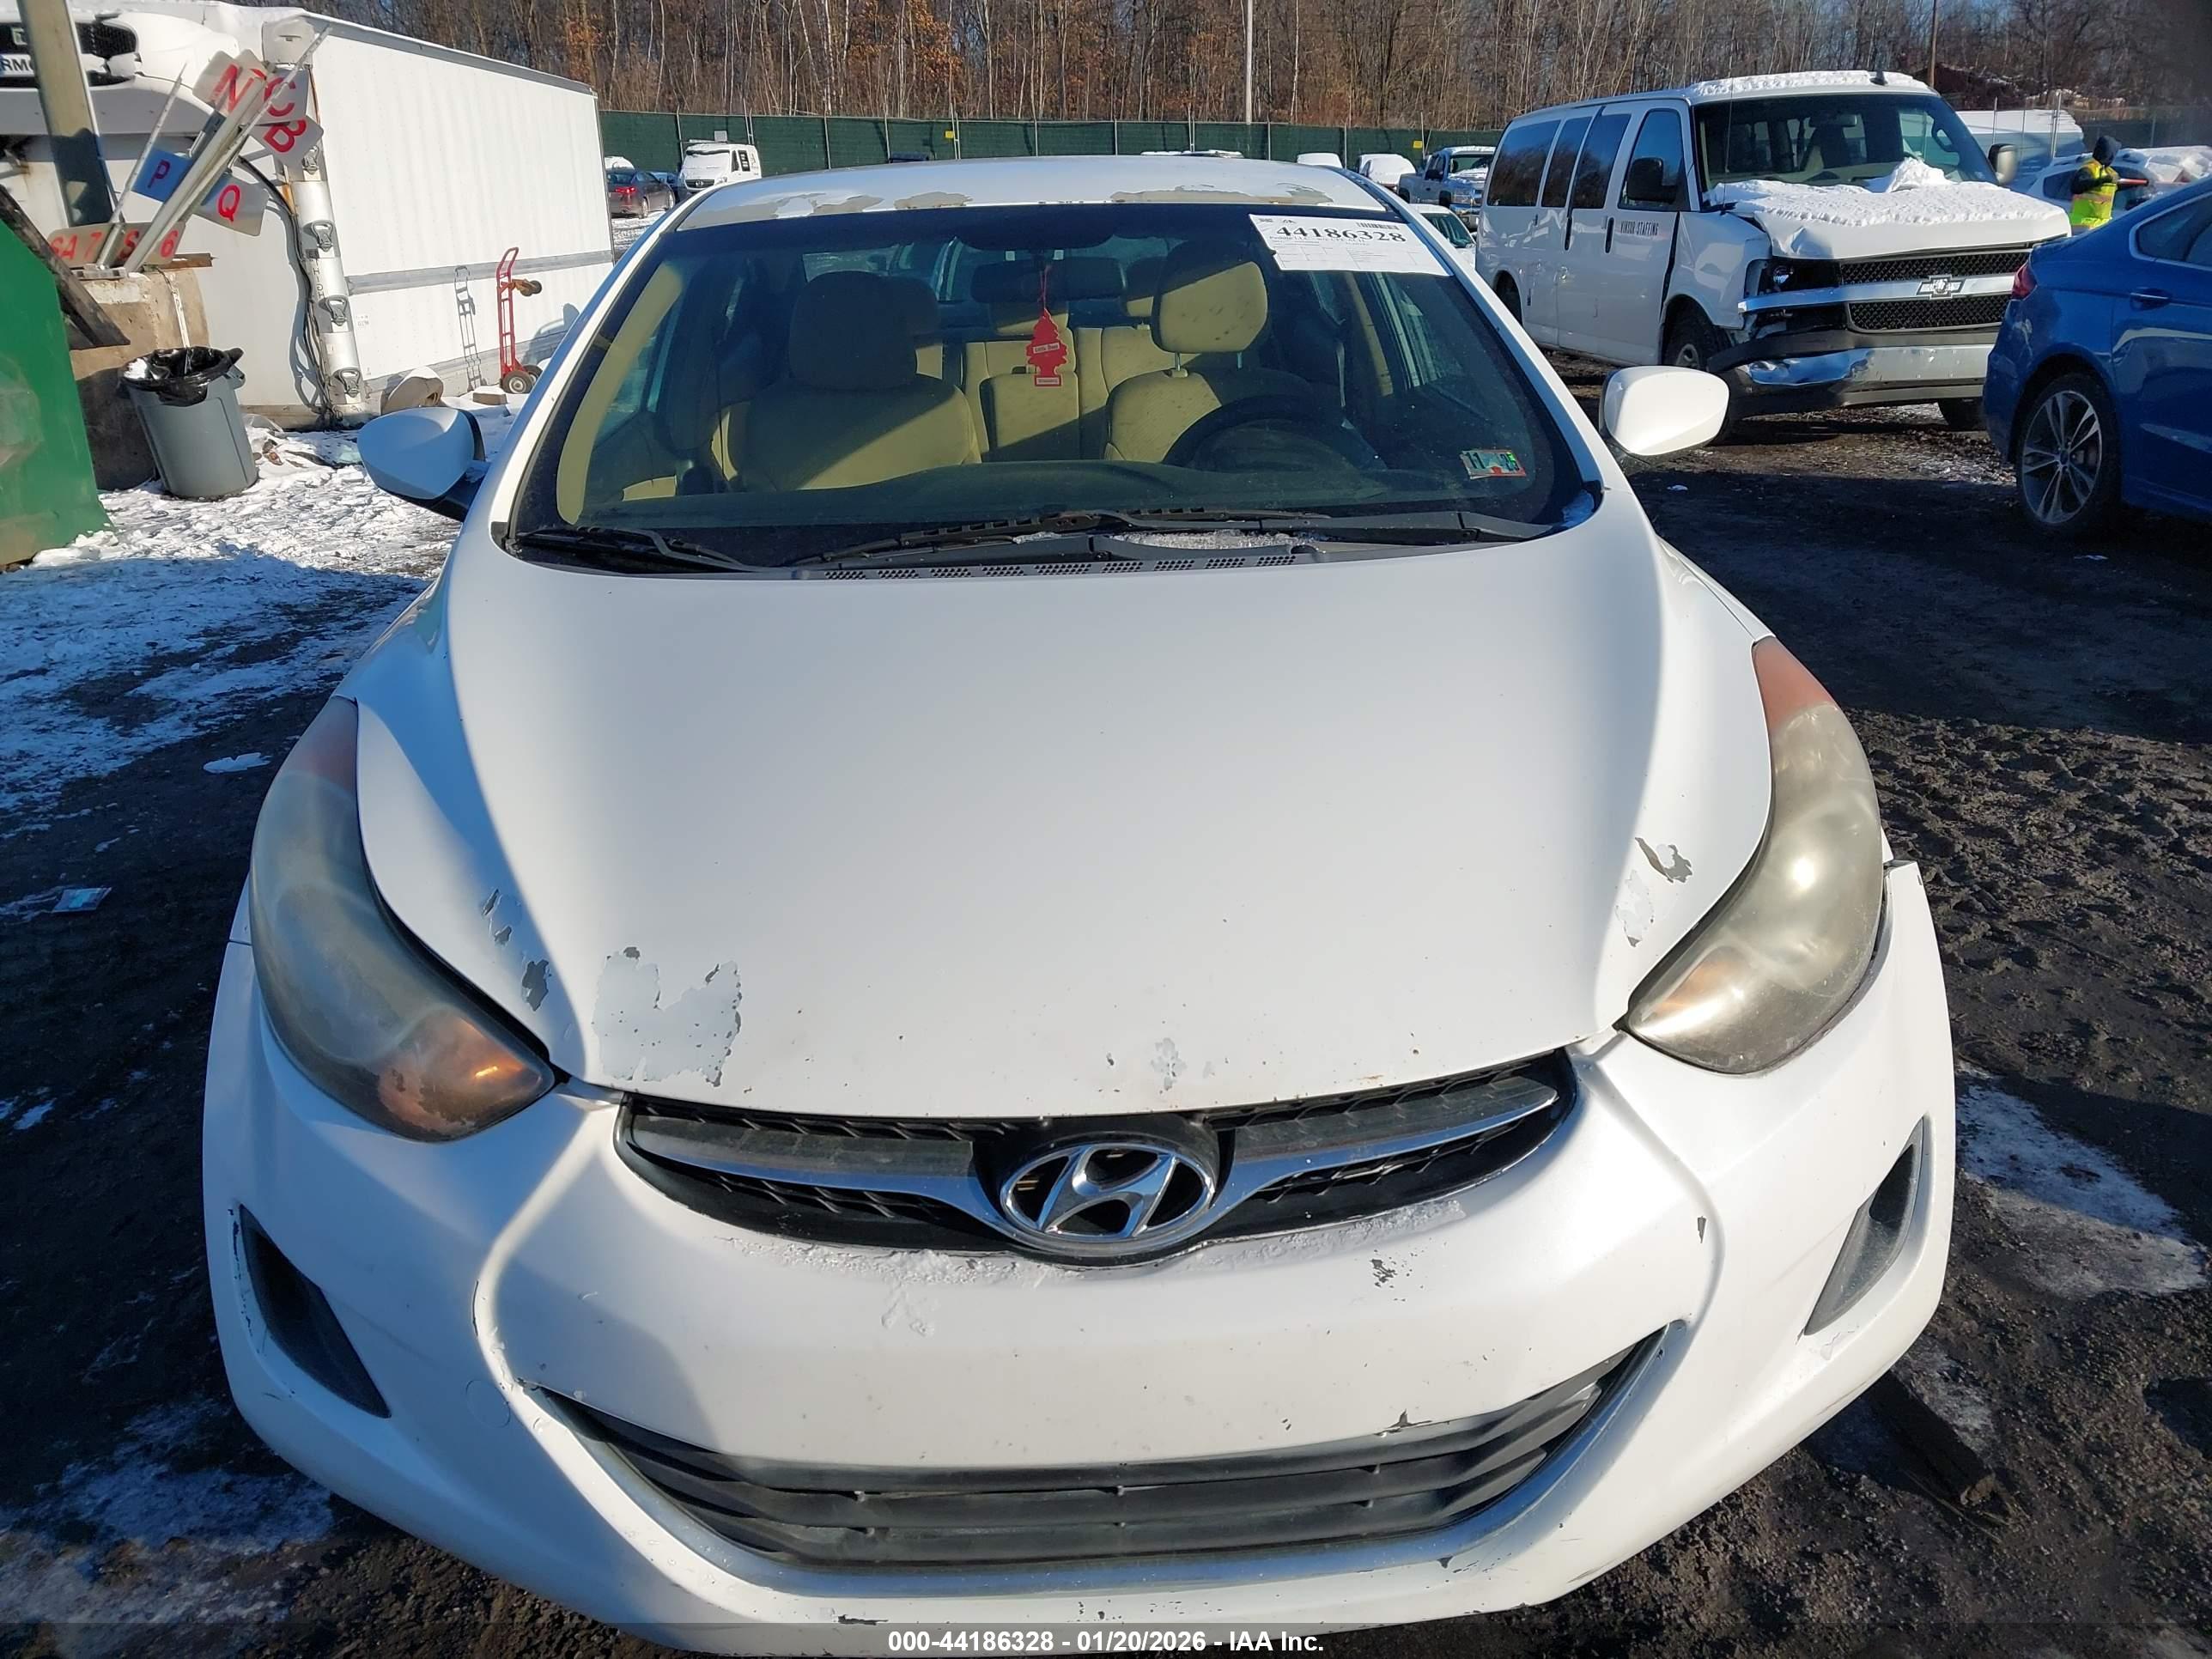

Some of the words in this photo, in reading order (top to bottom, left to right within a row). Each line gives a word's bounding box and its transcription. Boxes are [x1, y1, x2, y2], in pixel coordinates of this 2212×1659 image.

[264, 76, 296, 118] C
[264, 118, 307, 153] B
[148, 159, 171, 189] P
[217, 185, 241, 222] Q
[1276, 226, 1407, 242] 44186328
[1463, 452, 1486, 470] 11
